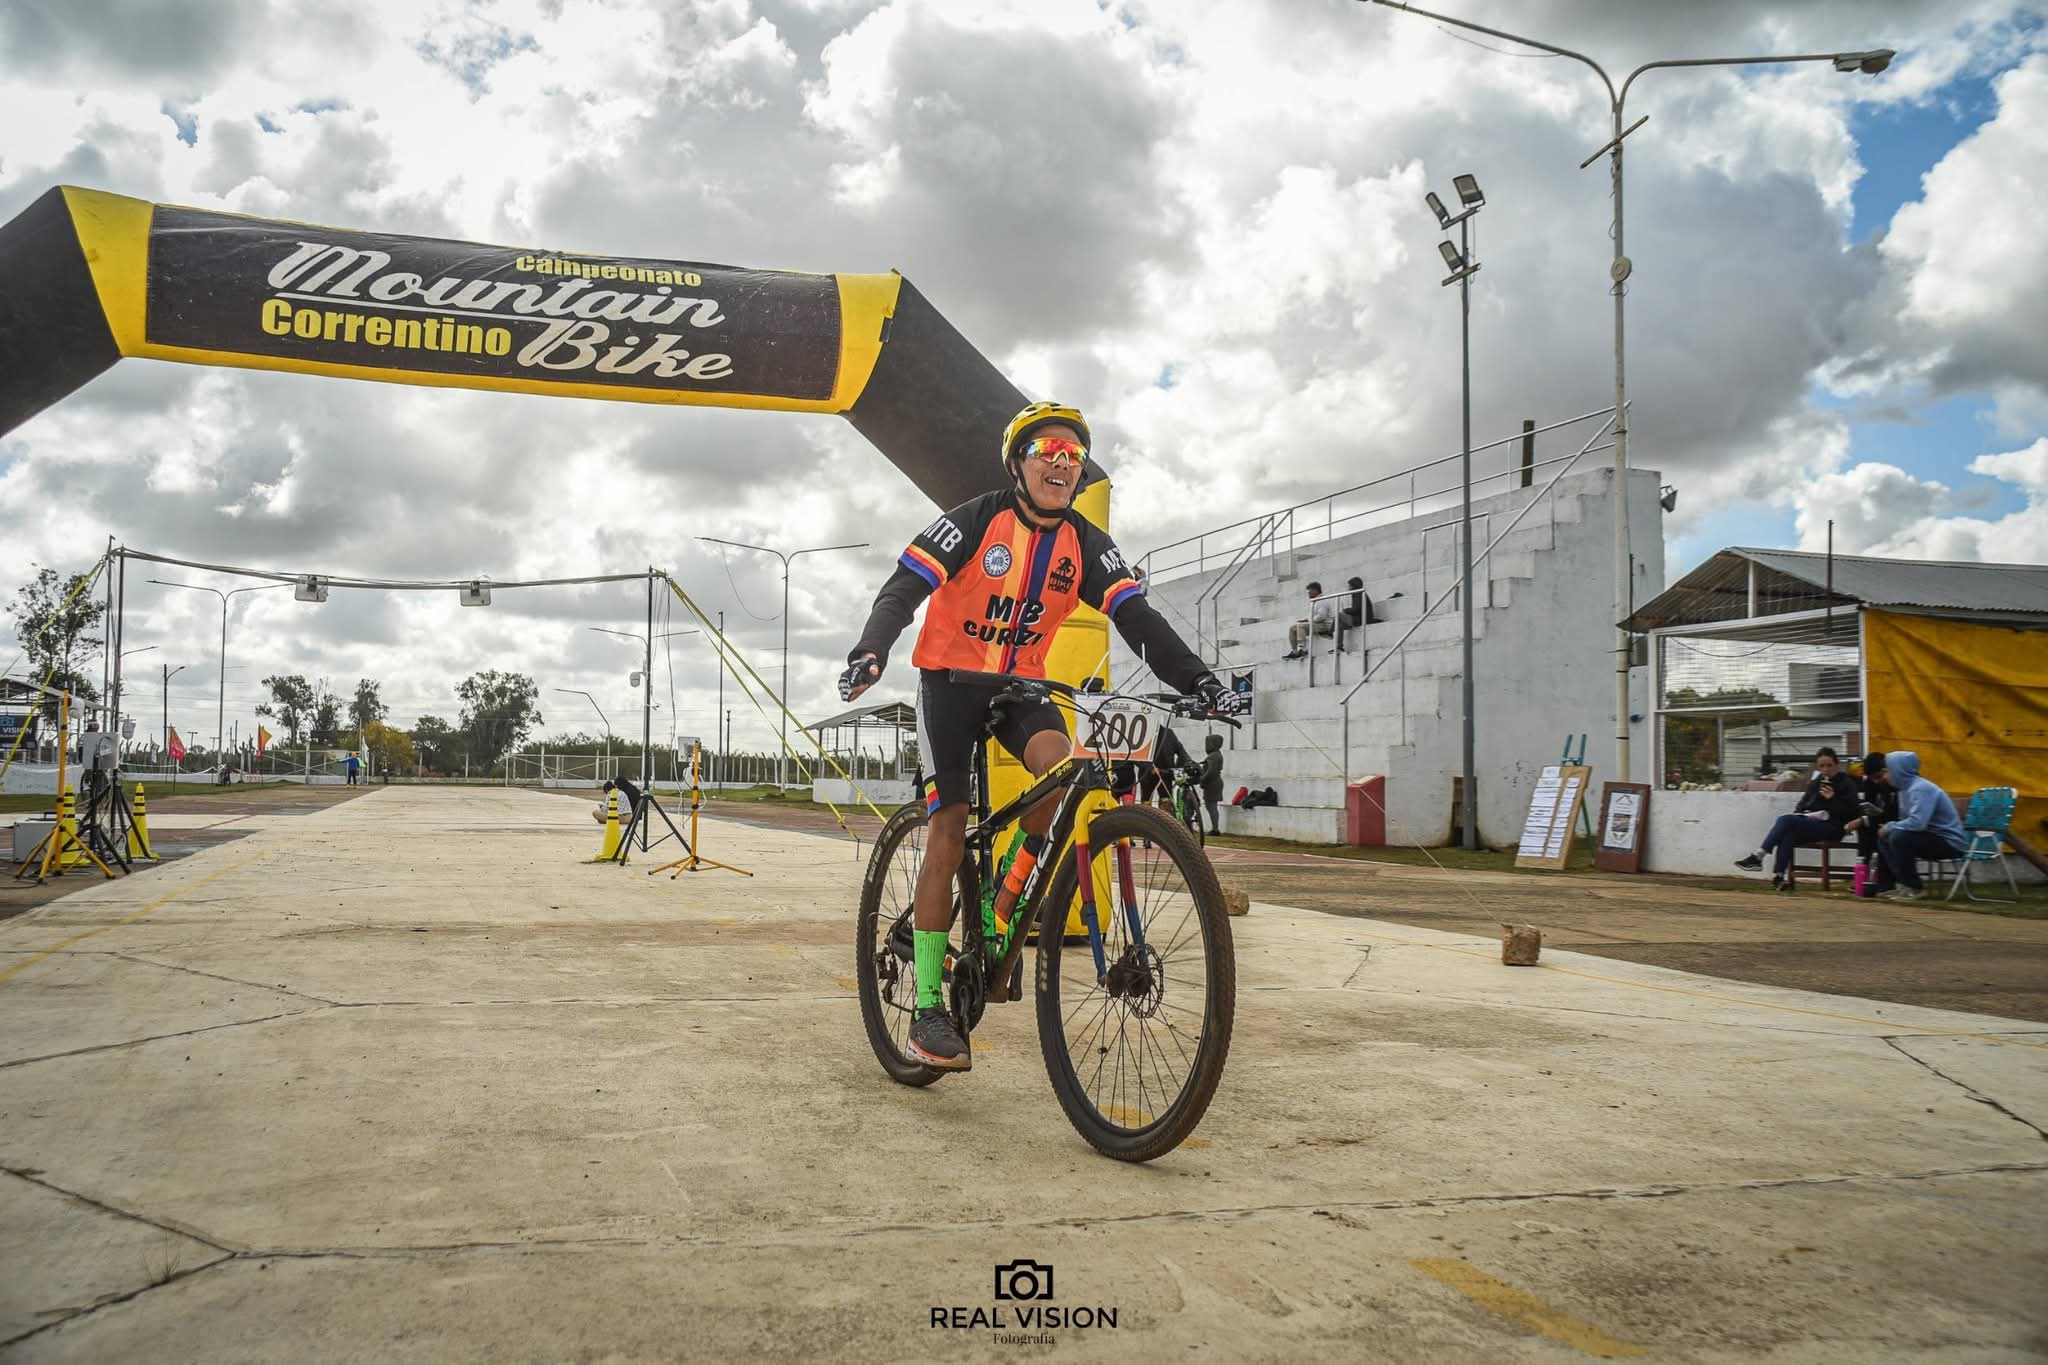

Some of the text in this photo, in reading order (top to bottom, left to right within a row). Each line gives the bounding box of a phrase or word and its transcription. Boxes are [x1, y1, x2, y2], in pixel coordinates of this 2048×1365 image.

[267, 241, 726, 328] Mountain
[261, 298, 512, 356] Correntino
[517, 320, 734, 380] Bike
[923, 517, 963, 553] MTB
[1084, 711, 1148, 751] 200
